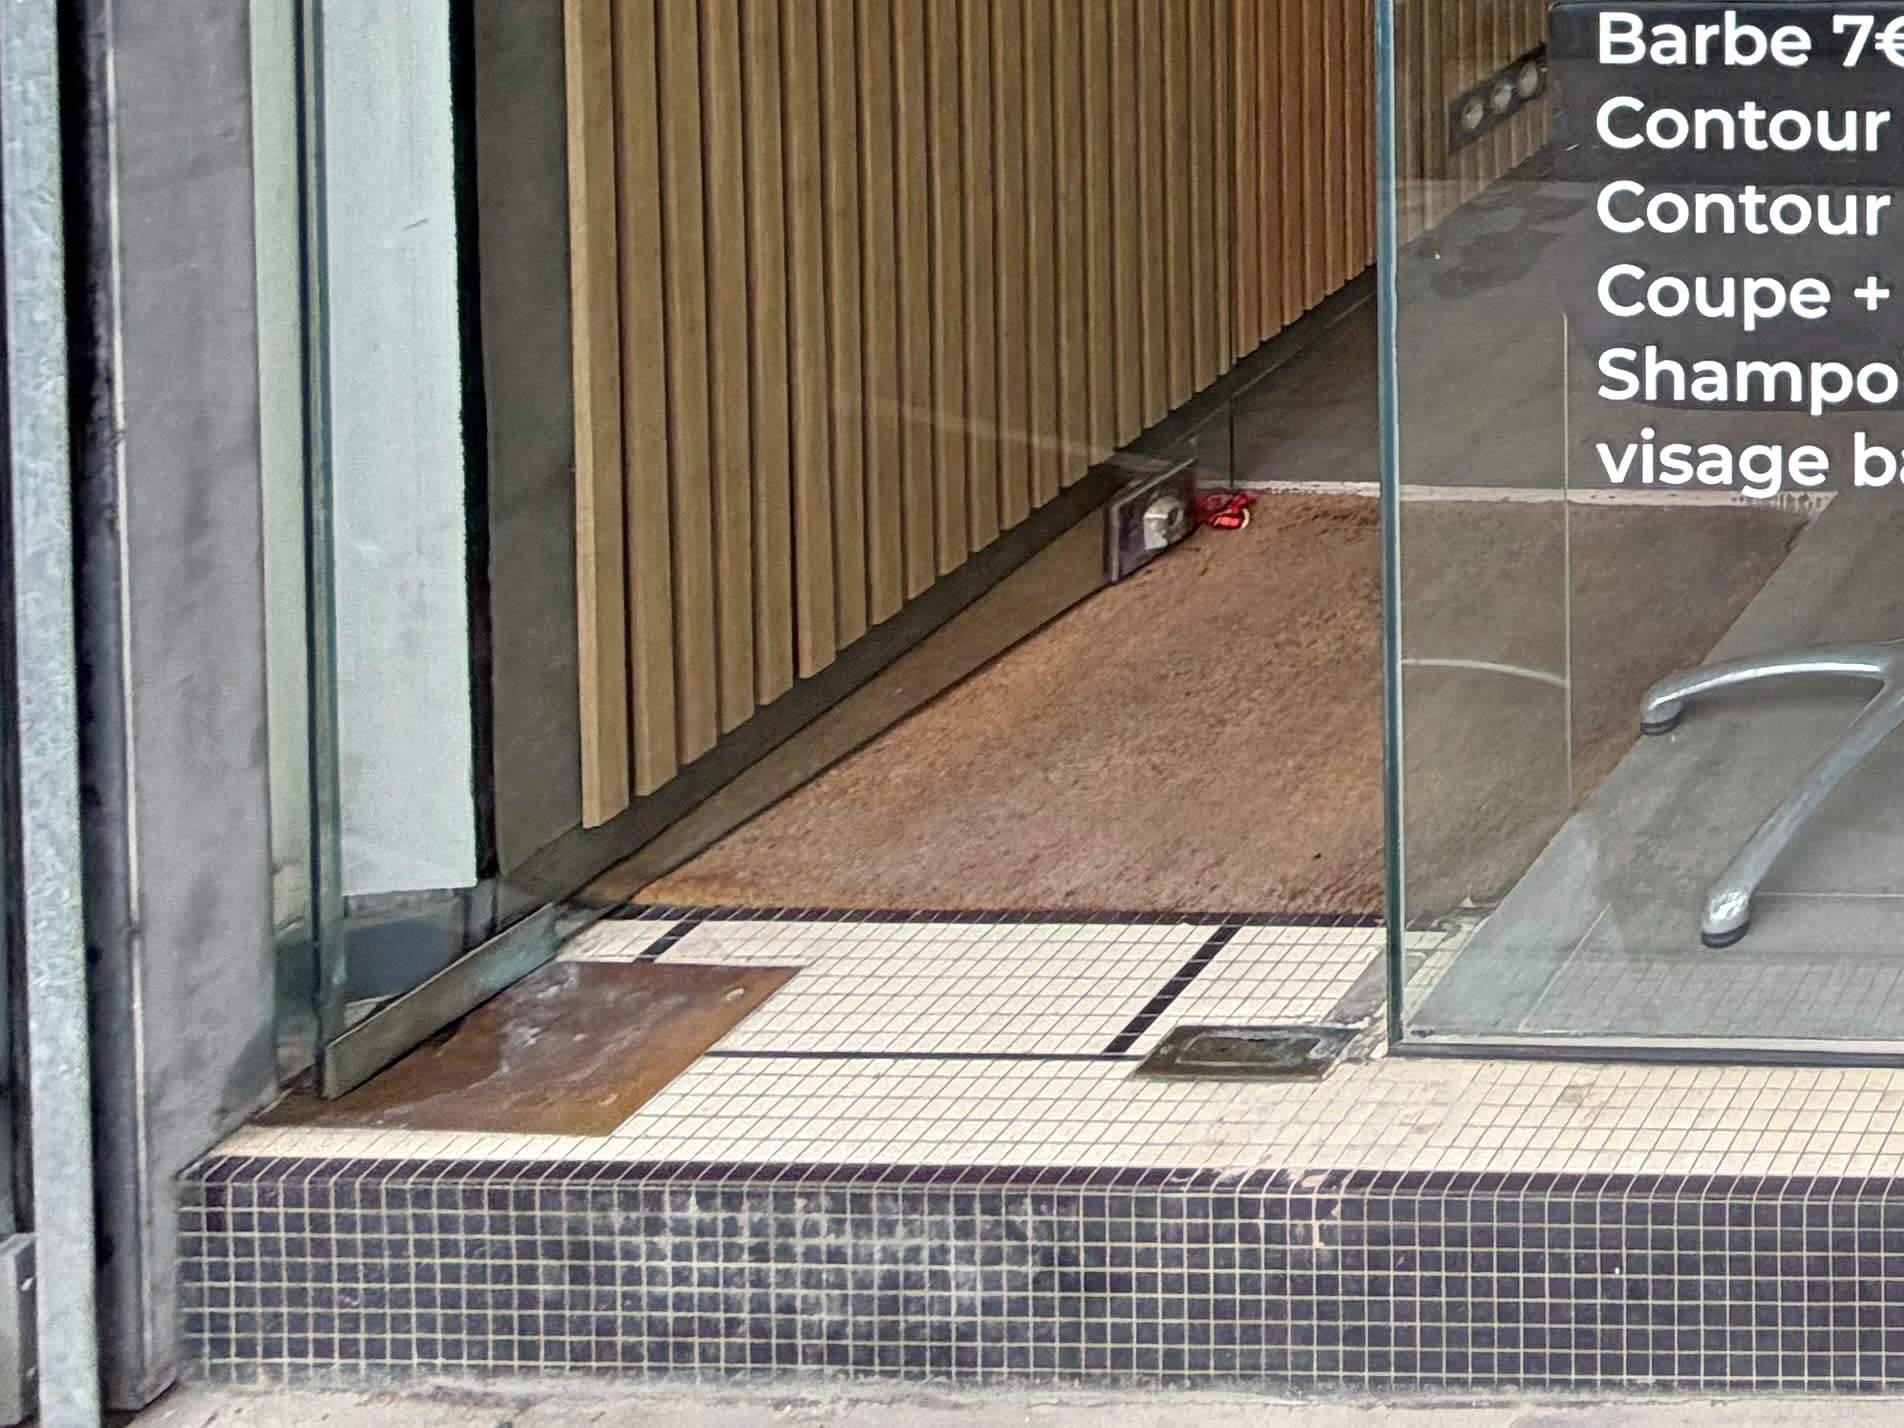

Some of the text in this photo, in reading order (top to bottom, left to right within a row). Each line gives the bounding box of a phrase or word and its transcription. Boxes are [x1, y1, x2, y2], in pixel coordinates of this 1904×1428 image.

[1599, 10, 1812, 67] Barbe
[1596, 96, 1891, 152] Contour
[1596, 179, 1891, 236] Contour
[1597, 263, 1831, 332] Coupe
[1854, 276, 1890, 311] +
[1596, 427, 1829, 499] visage
